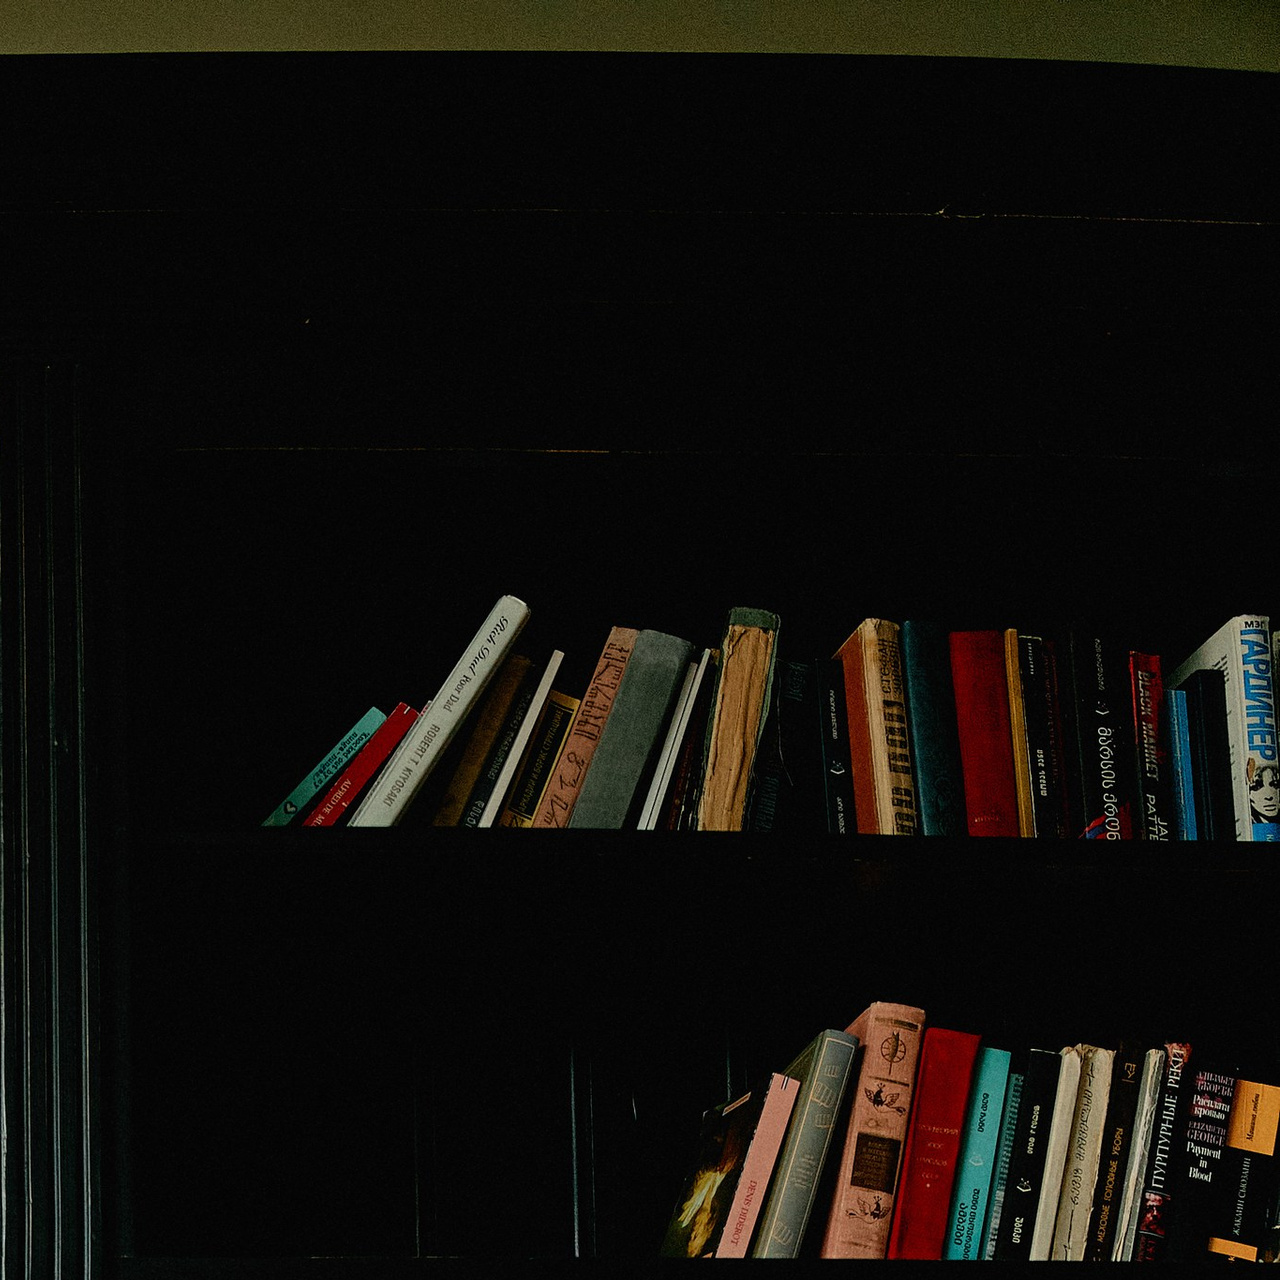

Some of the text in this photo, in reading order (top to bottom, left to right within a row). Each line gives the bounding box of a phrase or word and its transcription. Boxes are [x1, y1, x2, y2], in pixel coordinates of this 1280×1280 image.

[487, 616, 509, 646] Rich
[1244, 620, 1266, 629] МЭГ
[454, 674, 472, 698] Poor
[1240, 629, 1277, 761] ГАРДИНЕР
[443, 692, 460, 713] Dad
[1137, 670, 1159, 782] BLACK MARKET
[1193, 1094, 1230, 1112] Расплата
[1151, 1050, 1184, 1189] ПУРПУРНЫЕ РЕКИ
[1194, 1107, 1225, 1121] кровью
[1186, 1129, 1225, 1147] GEORGE
[1186, 1142, 1221, 1160] Payment
[1199, 1156, 1208, 1168] in
[1097, 1128, 1124, 1242] МЕХОВЫЕ ГОЛОВНЫЕ УБОРЫ
[1188, 1167, 1212, 1183] Blood
[731, 1180, 758, 1247] DENIS DIDEROT
